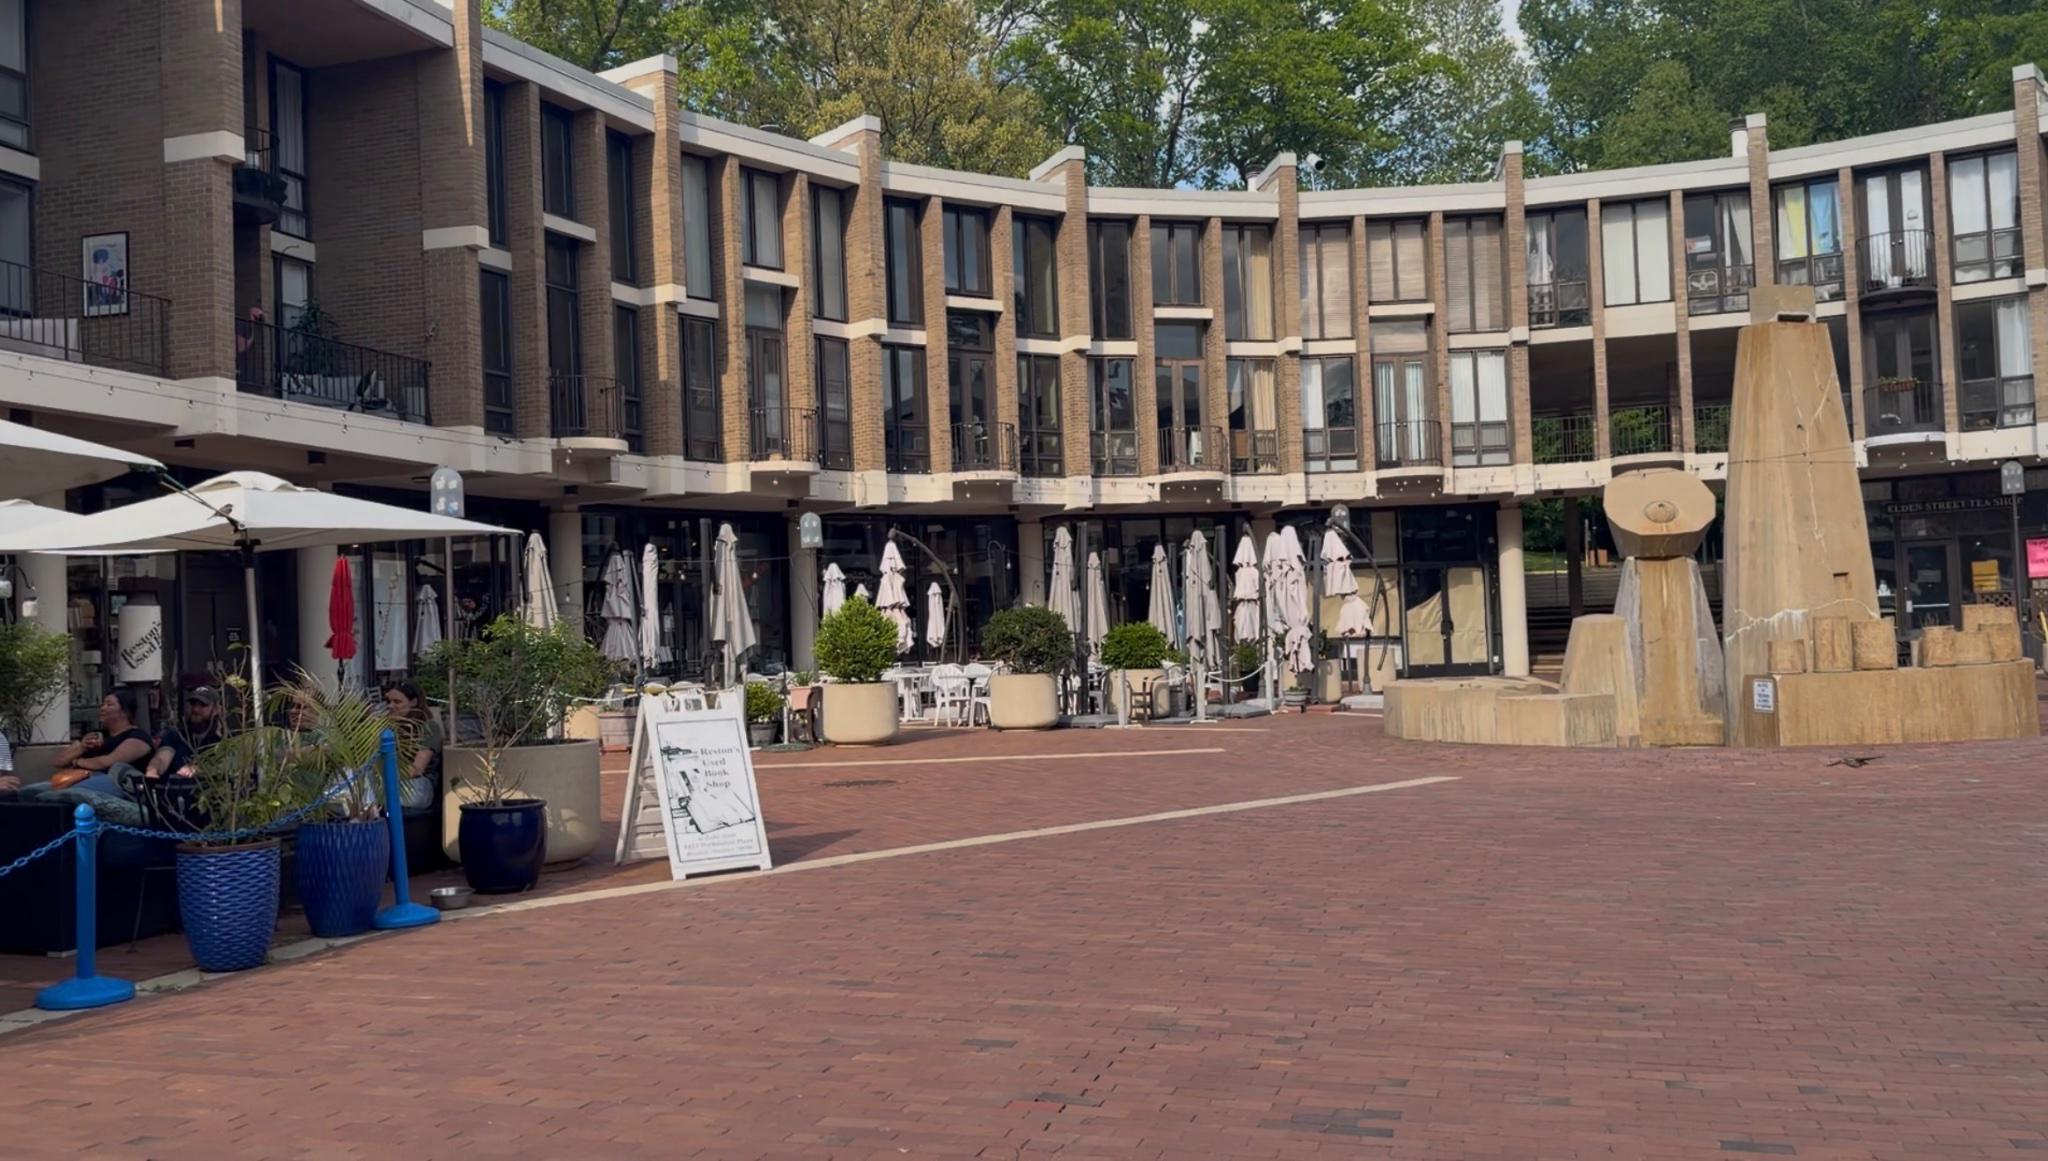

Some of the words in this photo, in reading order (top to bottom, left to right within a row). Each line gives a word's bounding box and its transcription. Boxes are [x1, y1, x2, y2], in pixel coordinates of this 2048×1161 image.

[1925, 500, 1966, 512] STREET
[1969, 498, 1991, 508] TEA
[705, 769, 729, 777] Book
[706, 781, 731, 789] Shop
